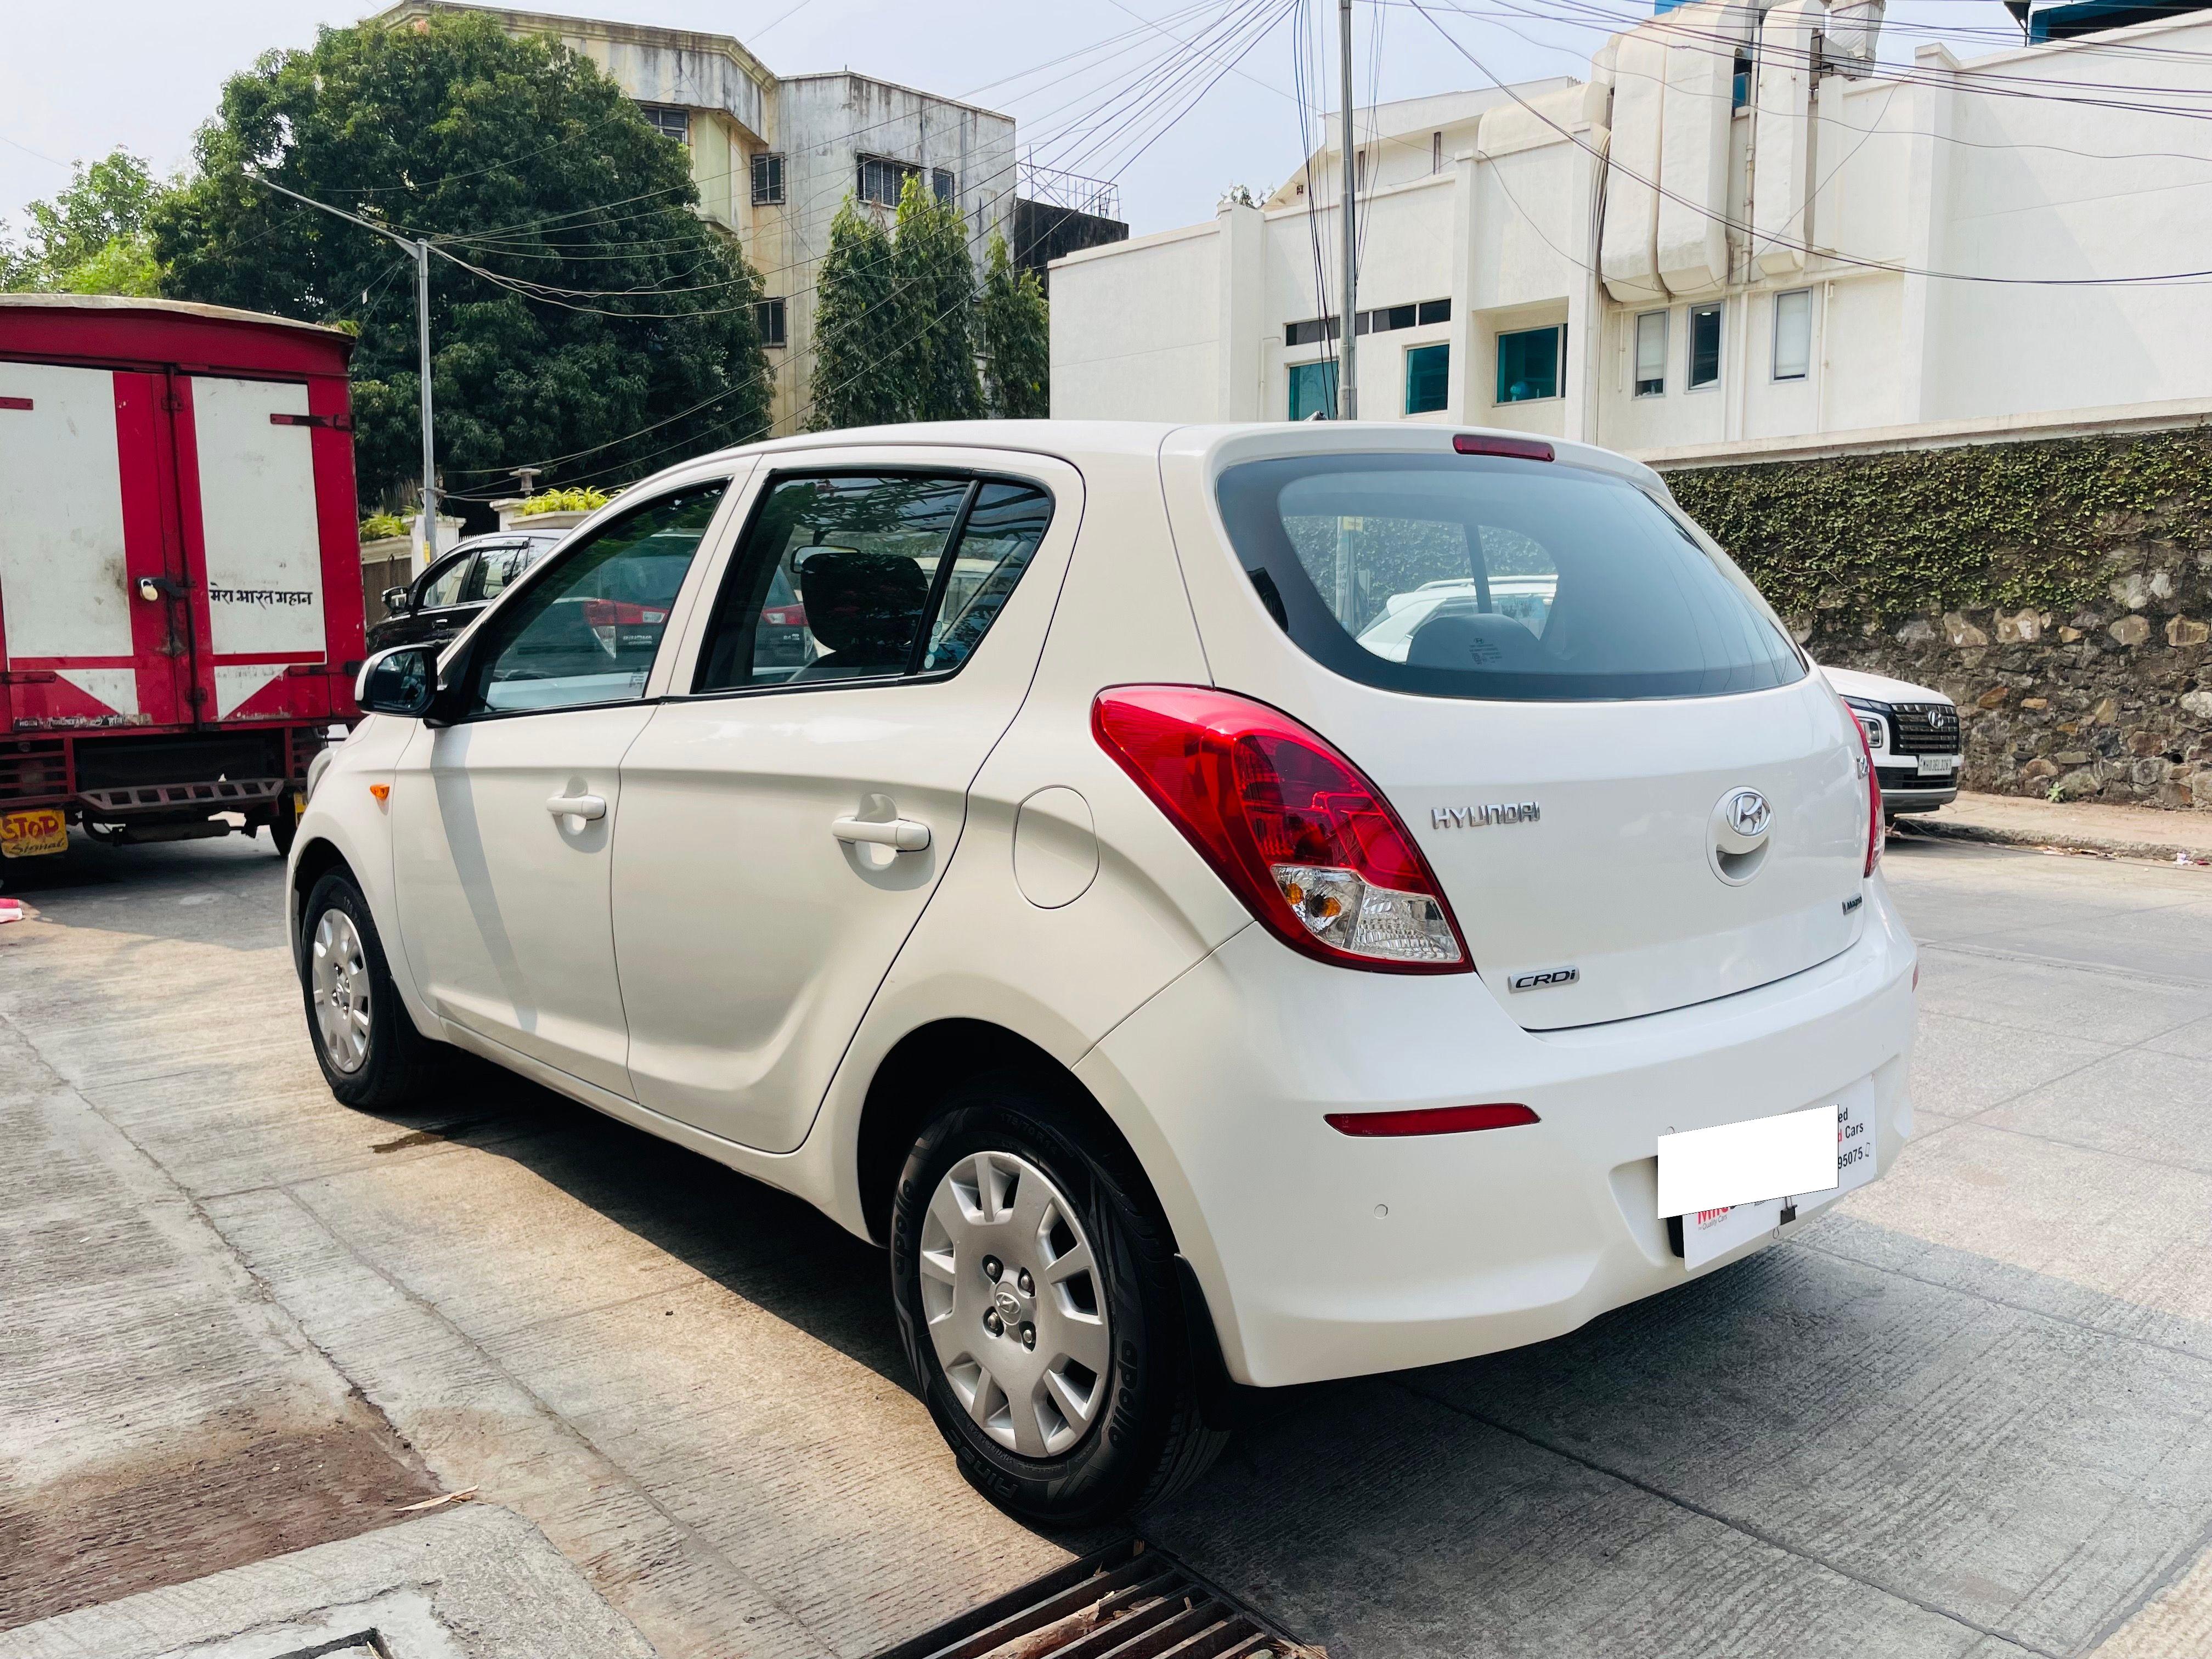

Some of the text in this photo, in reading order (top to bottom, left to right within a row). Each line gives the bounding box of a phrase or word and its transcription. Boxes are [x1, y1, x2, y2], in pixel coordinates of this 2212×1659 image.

[209, 582, 234, 605] मेरा
[236, 590, 274, 610] भारत
[1431, 802, 1541, 829] HYUNDAI
[1515, 969, 1576, 988] CRDi
[1845, 1122, 1864, 1138] Cars
[1702, 1218, 1718, 1230] Quality
[1718, 1214, 1728, 1223] Cars
